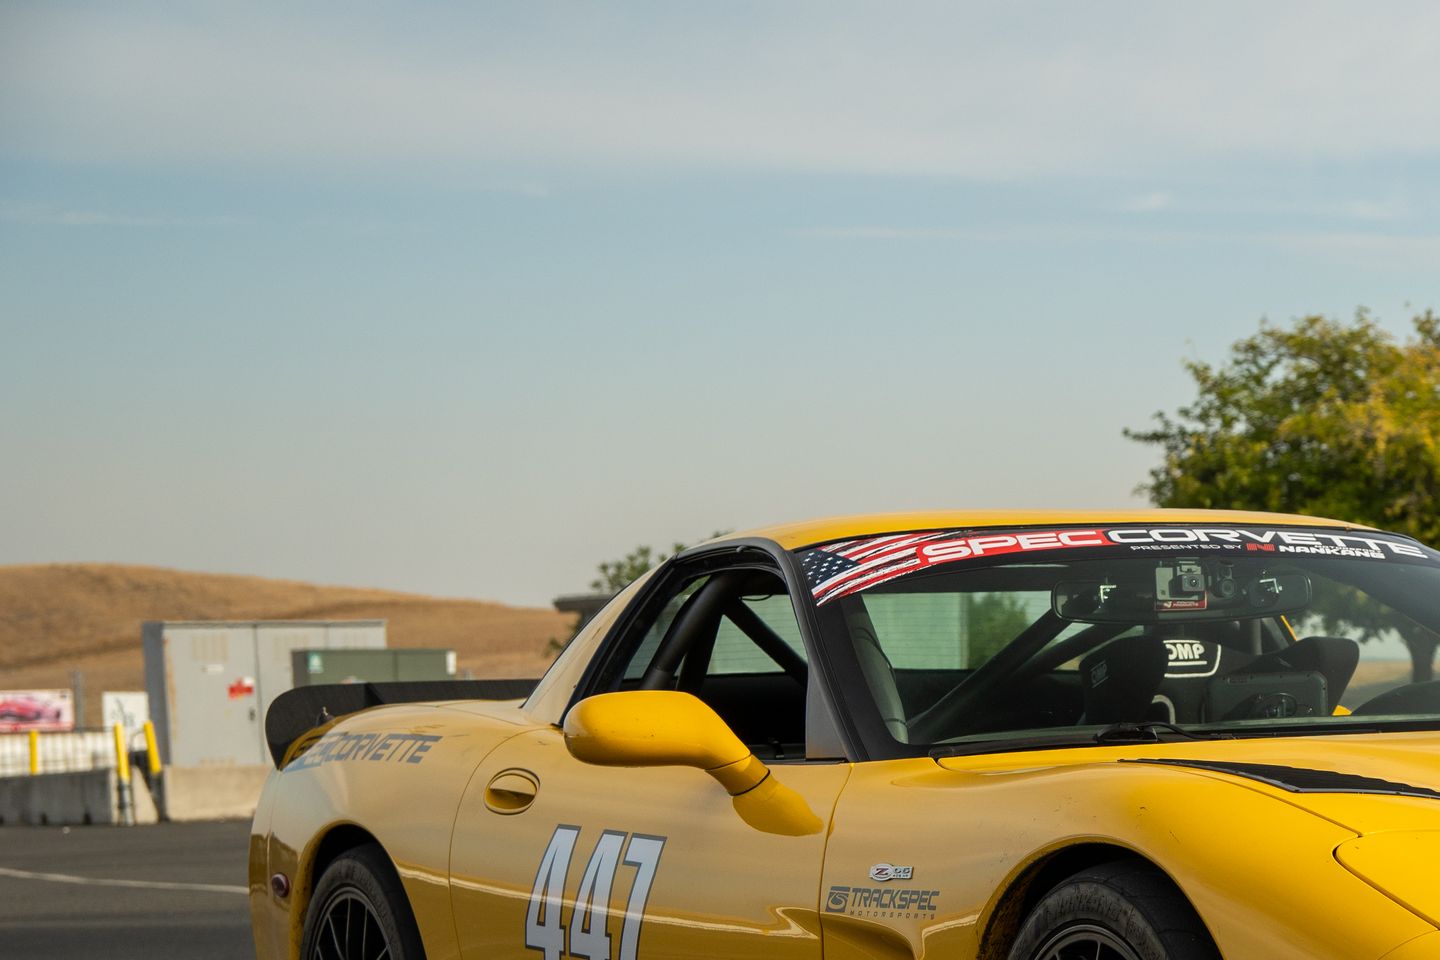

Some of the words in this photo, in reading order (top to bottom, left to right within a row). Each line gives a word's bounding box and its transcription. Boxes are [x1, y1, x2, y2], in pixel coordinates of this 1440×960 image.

[922, 530, 1102, 563] SPEC
[1108, 529, 1428, 559] CORVETTE
[1130, 543, 1221, 551] PRESENTED
[1279, 545, 1386, 560] NANKANG
[851, 887, 941, 911] TRACKSPEC
[850, 910, 935, 921] MOTORSPORTS
